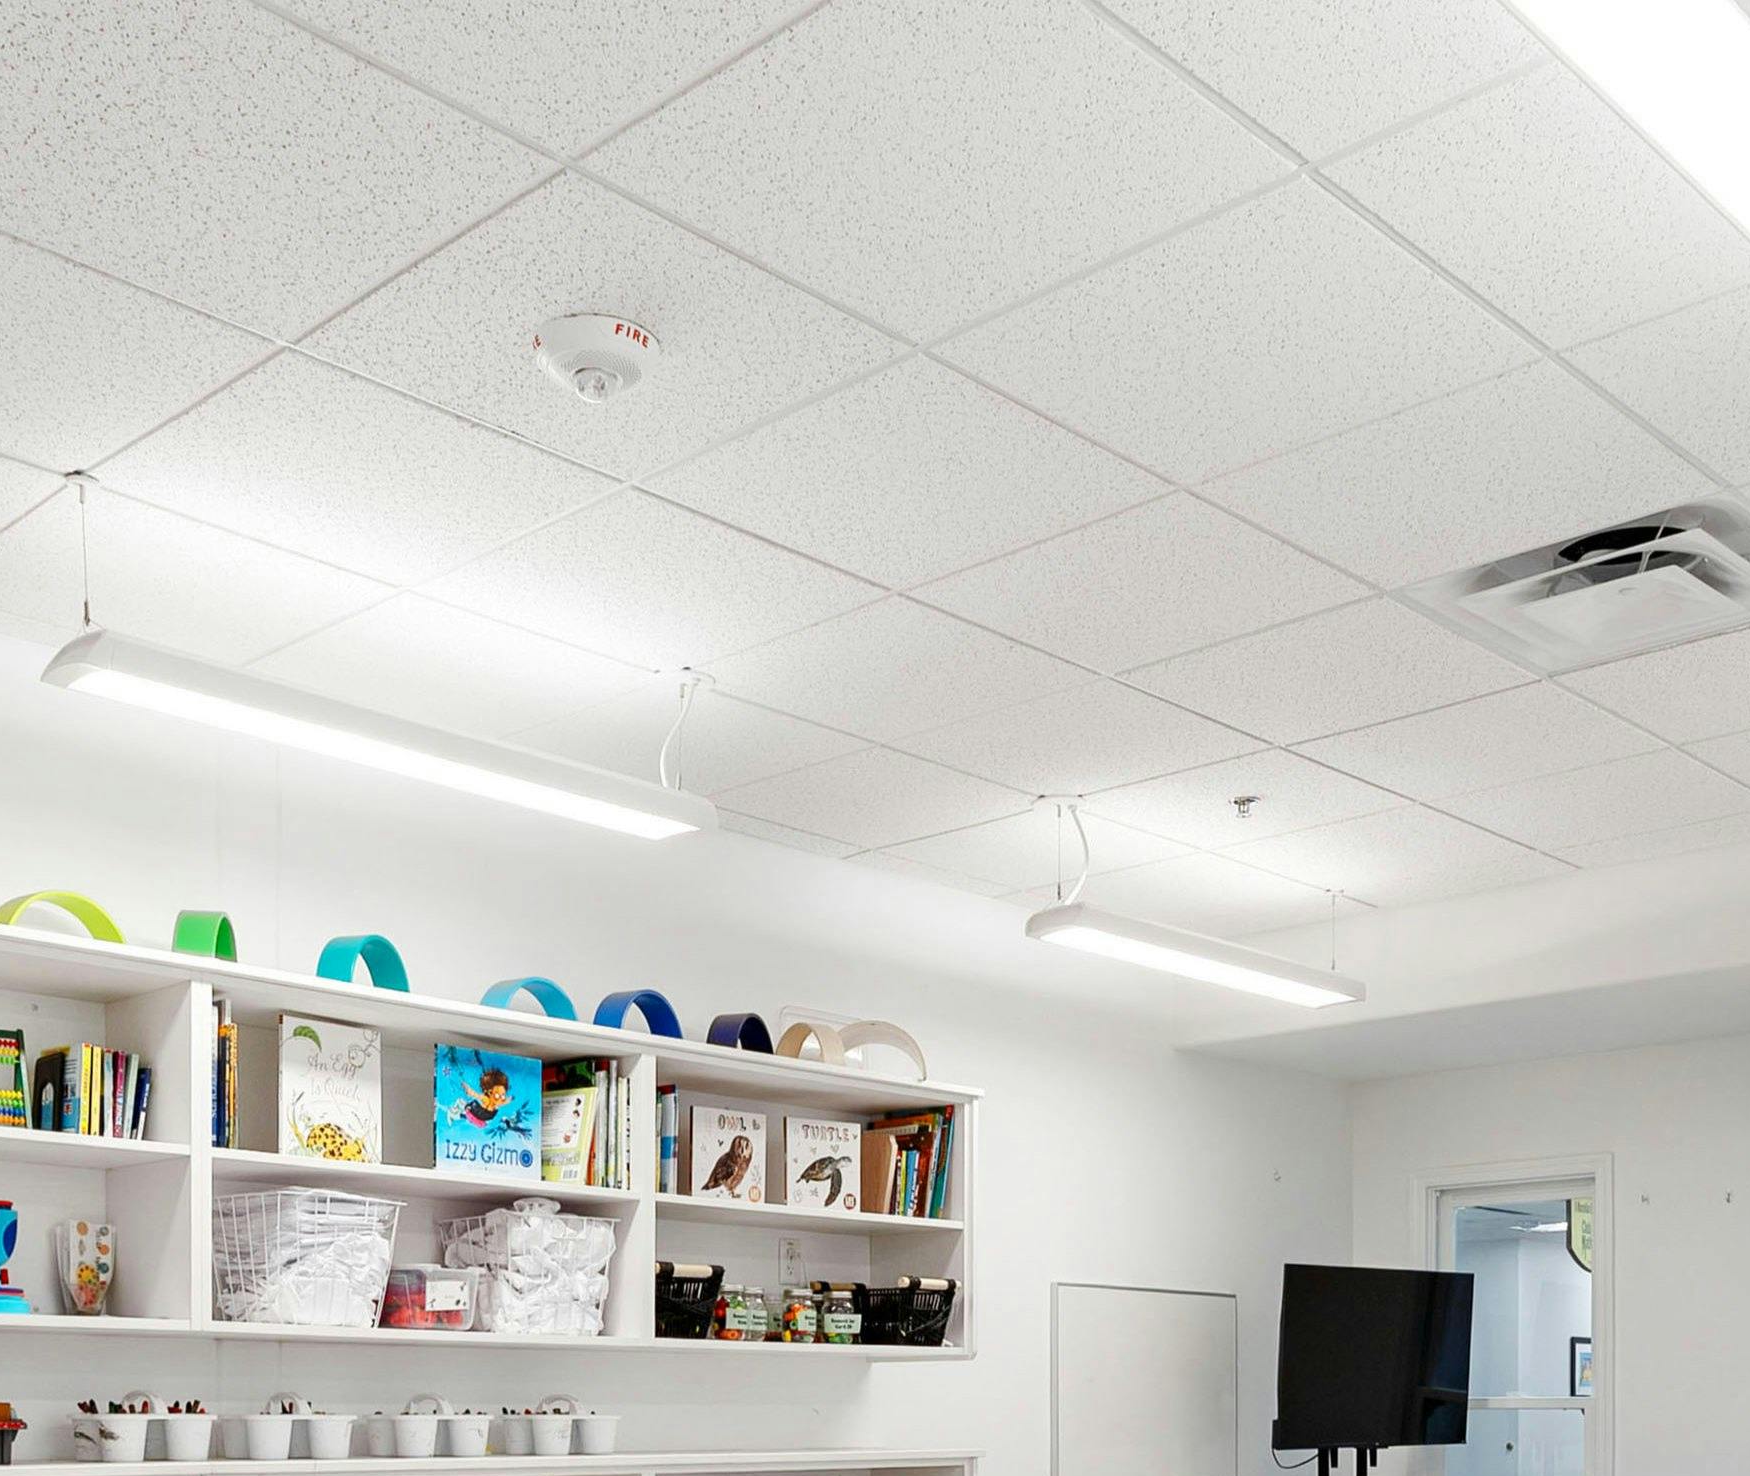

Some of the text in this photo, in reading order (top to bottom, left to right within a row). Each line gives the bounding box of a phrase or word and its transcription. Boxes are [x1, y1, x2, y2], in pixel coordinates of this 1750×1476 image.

[615, 323, 649, 348] FIRE
[307, 1052, 357, 1080] An Egg
[718, 1114, 747, 1131] OWL
[802, 1124, 850, 1142] TURTLE
[445, 1139, 477, 1162] Izzy
[481, 1141, 534, 1168] Gizmo
